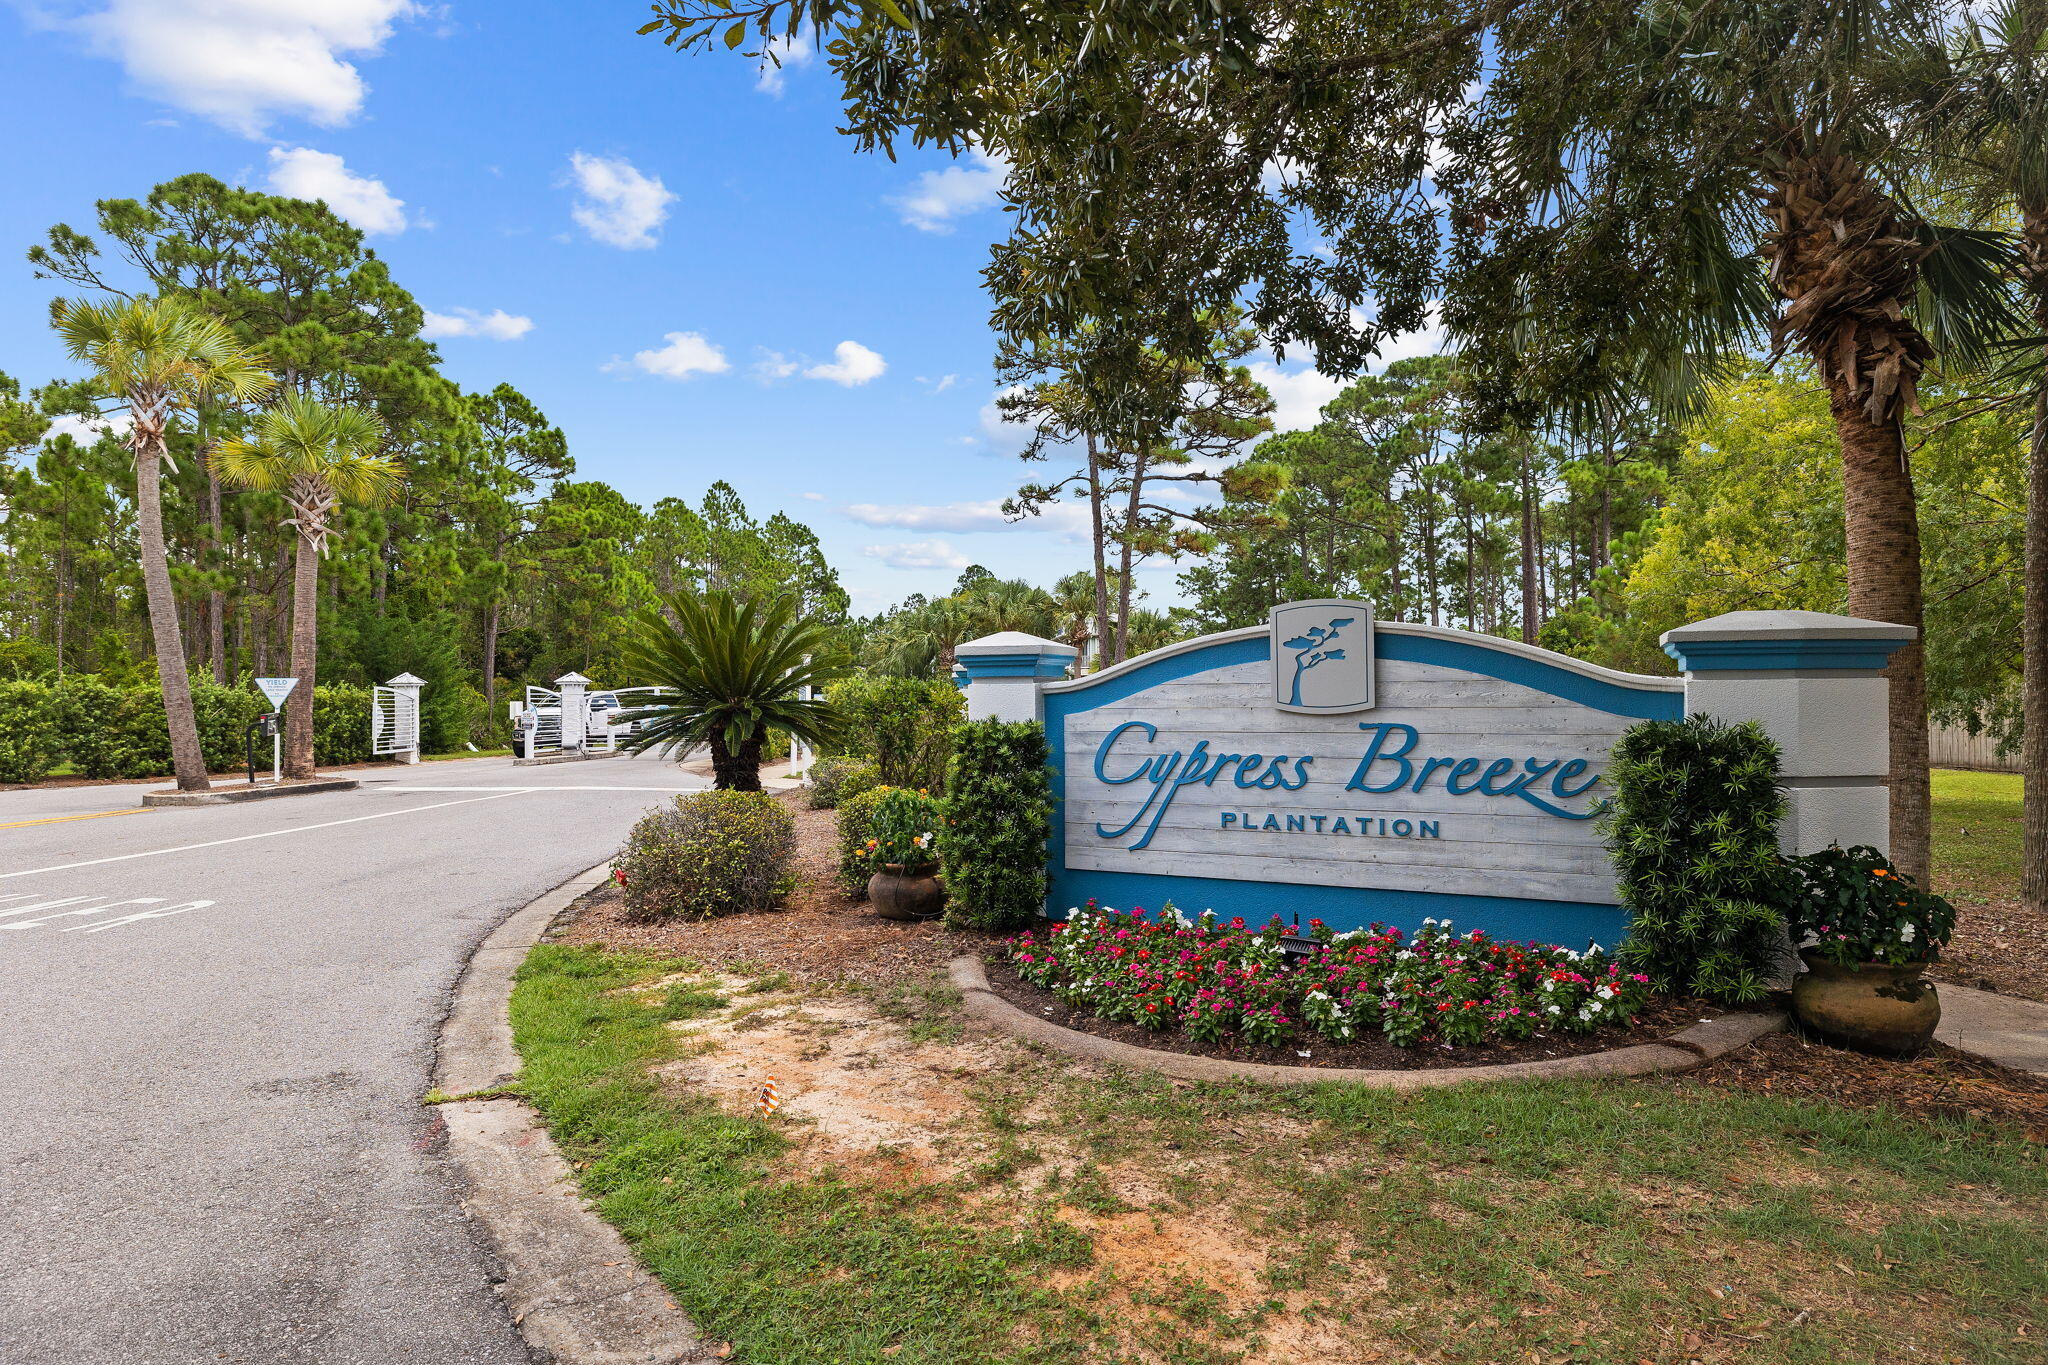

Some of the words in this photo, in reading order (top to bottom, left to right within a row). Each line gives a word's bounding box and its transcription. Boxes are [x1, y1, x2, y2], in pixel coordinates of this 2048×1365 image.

[1094, 721, 1314, 853] Cypress
[1344, 722, 1607, 820] Breeze
[1221, 811, 1440, 839] PLANTATION
